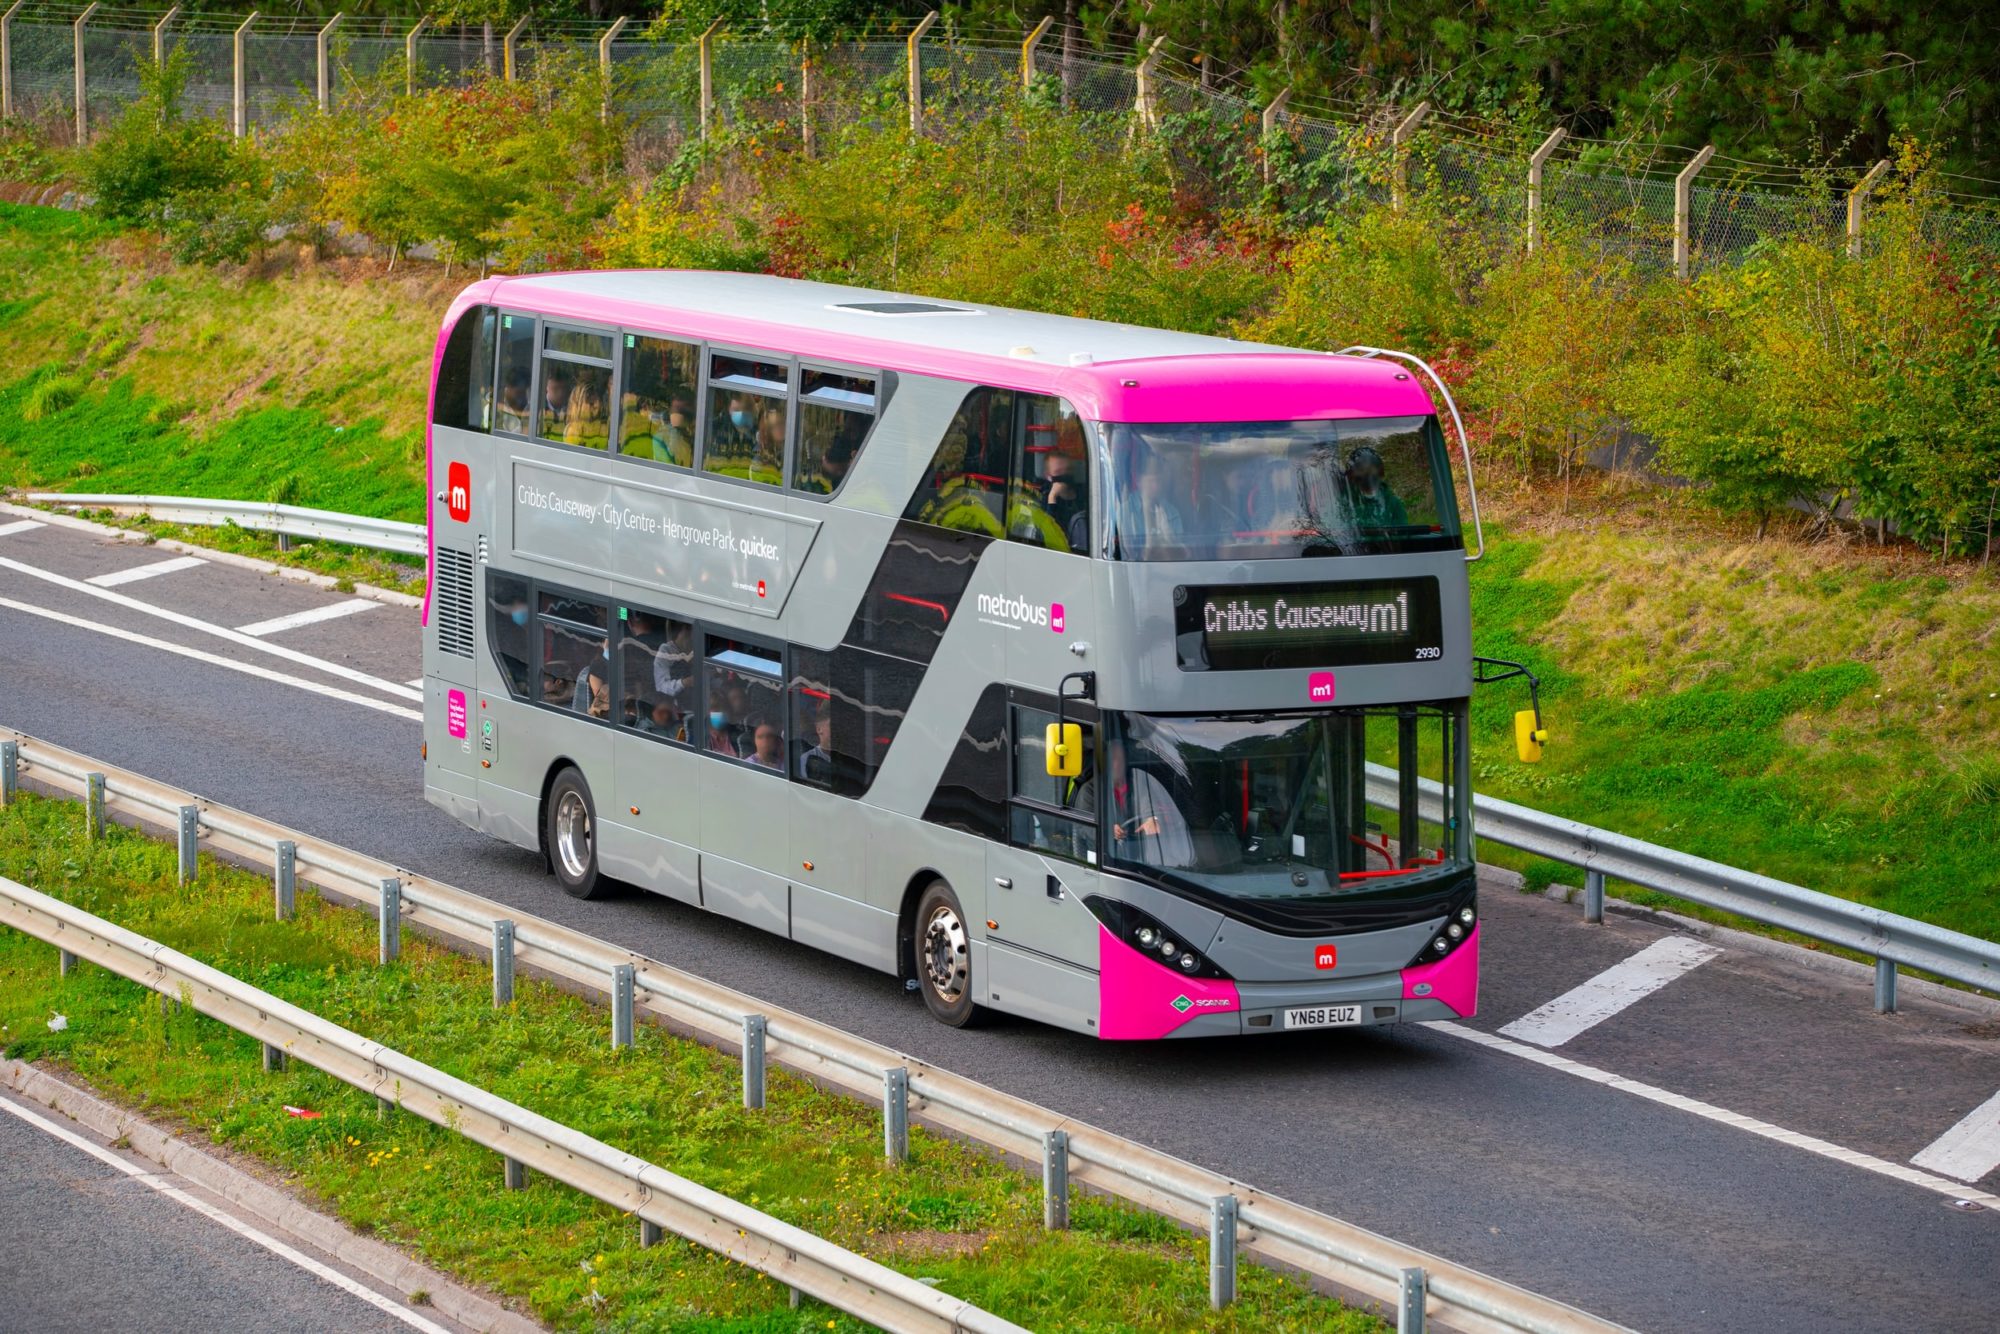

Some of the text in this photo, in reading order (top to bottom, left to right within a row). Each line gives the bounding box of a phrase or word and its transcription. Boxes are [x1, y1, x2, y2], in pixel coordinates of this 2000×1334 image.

[452, 486, 466, 511] m
[518, 485, 547, 509] Cribbs
[548, 491, 596, 524] Causeway
[603, 503, 622, 530] City
[623, 508, 656, 534] Centre
[663, 516, 711, 546] Hengrove
[712, 528, 738, 552] Park.
[739, 535, 779, 561] quicker.
[978, 594, 1047, 626] metrobus
[1203, 592, 1408, 632] Cribbs Causeway m1
[1415, 647, 1440, 659] 2930
[1313, 684, 1331, 696] m1
[1319, 954, 1333, 965] m
[1290, 1007, 1356, 1026] YN68 EUZ
